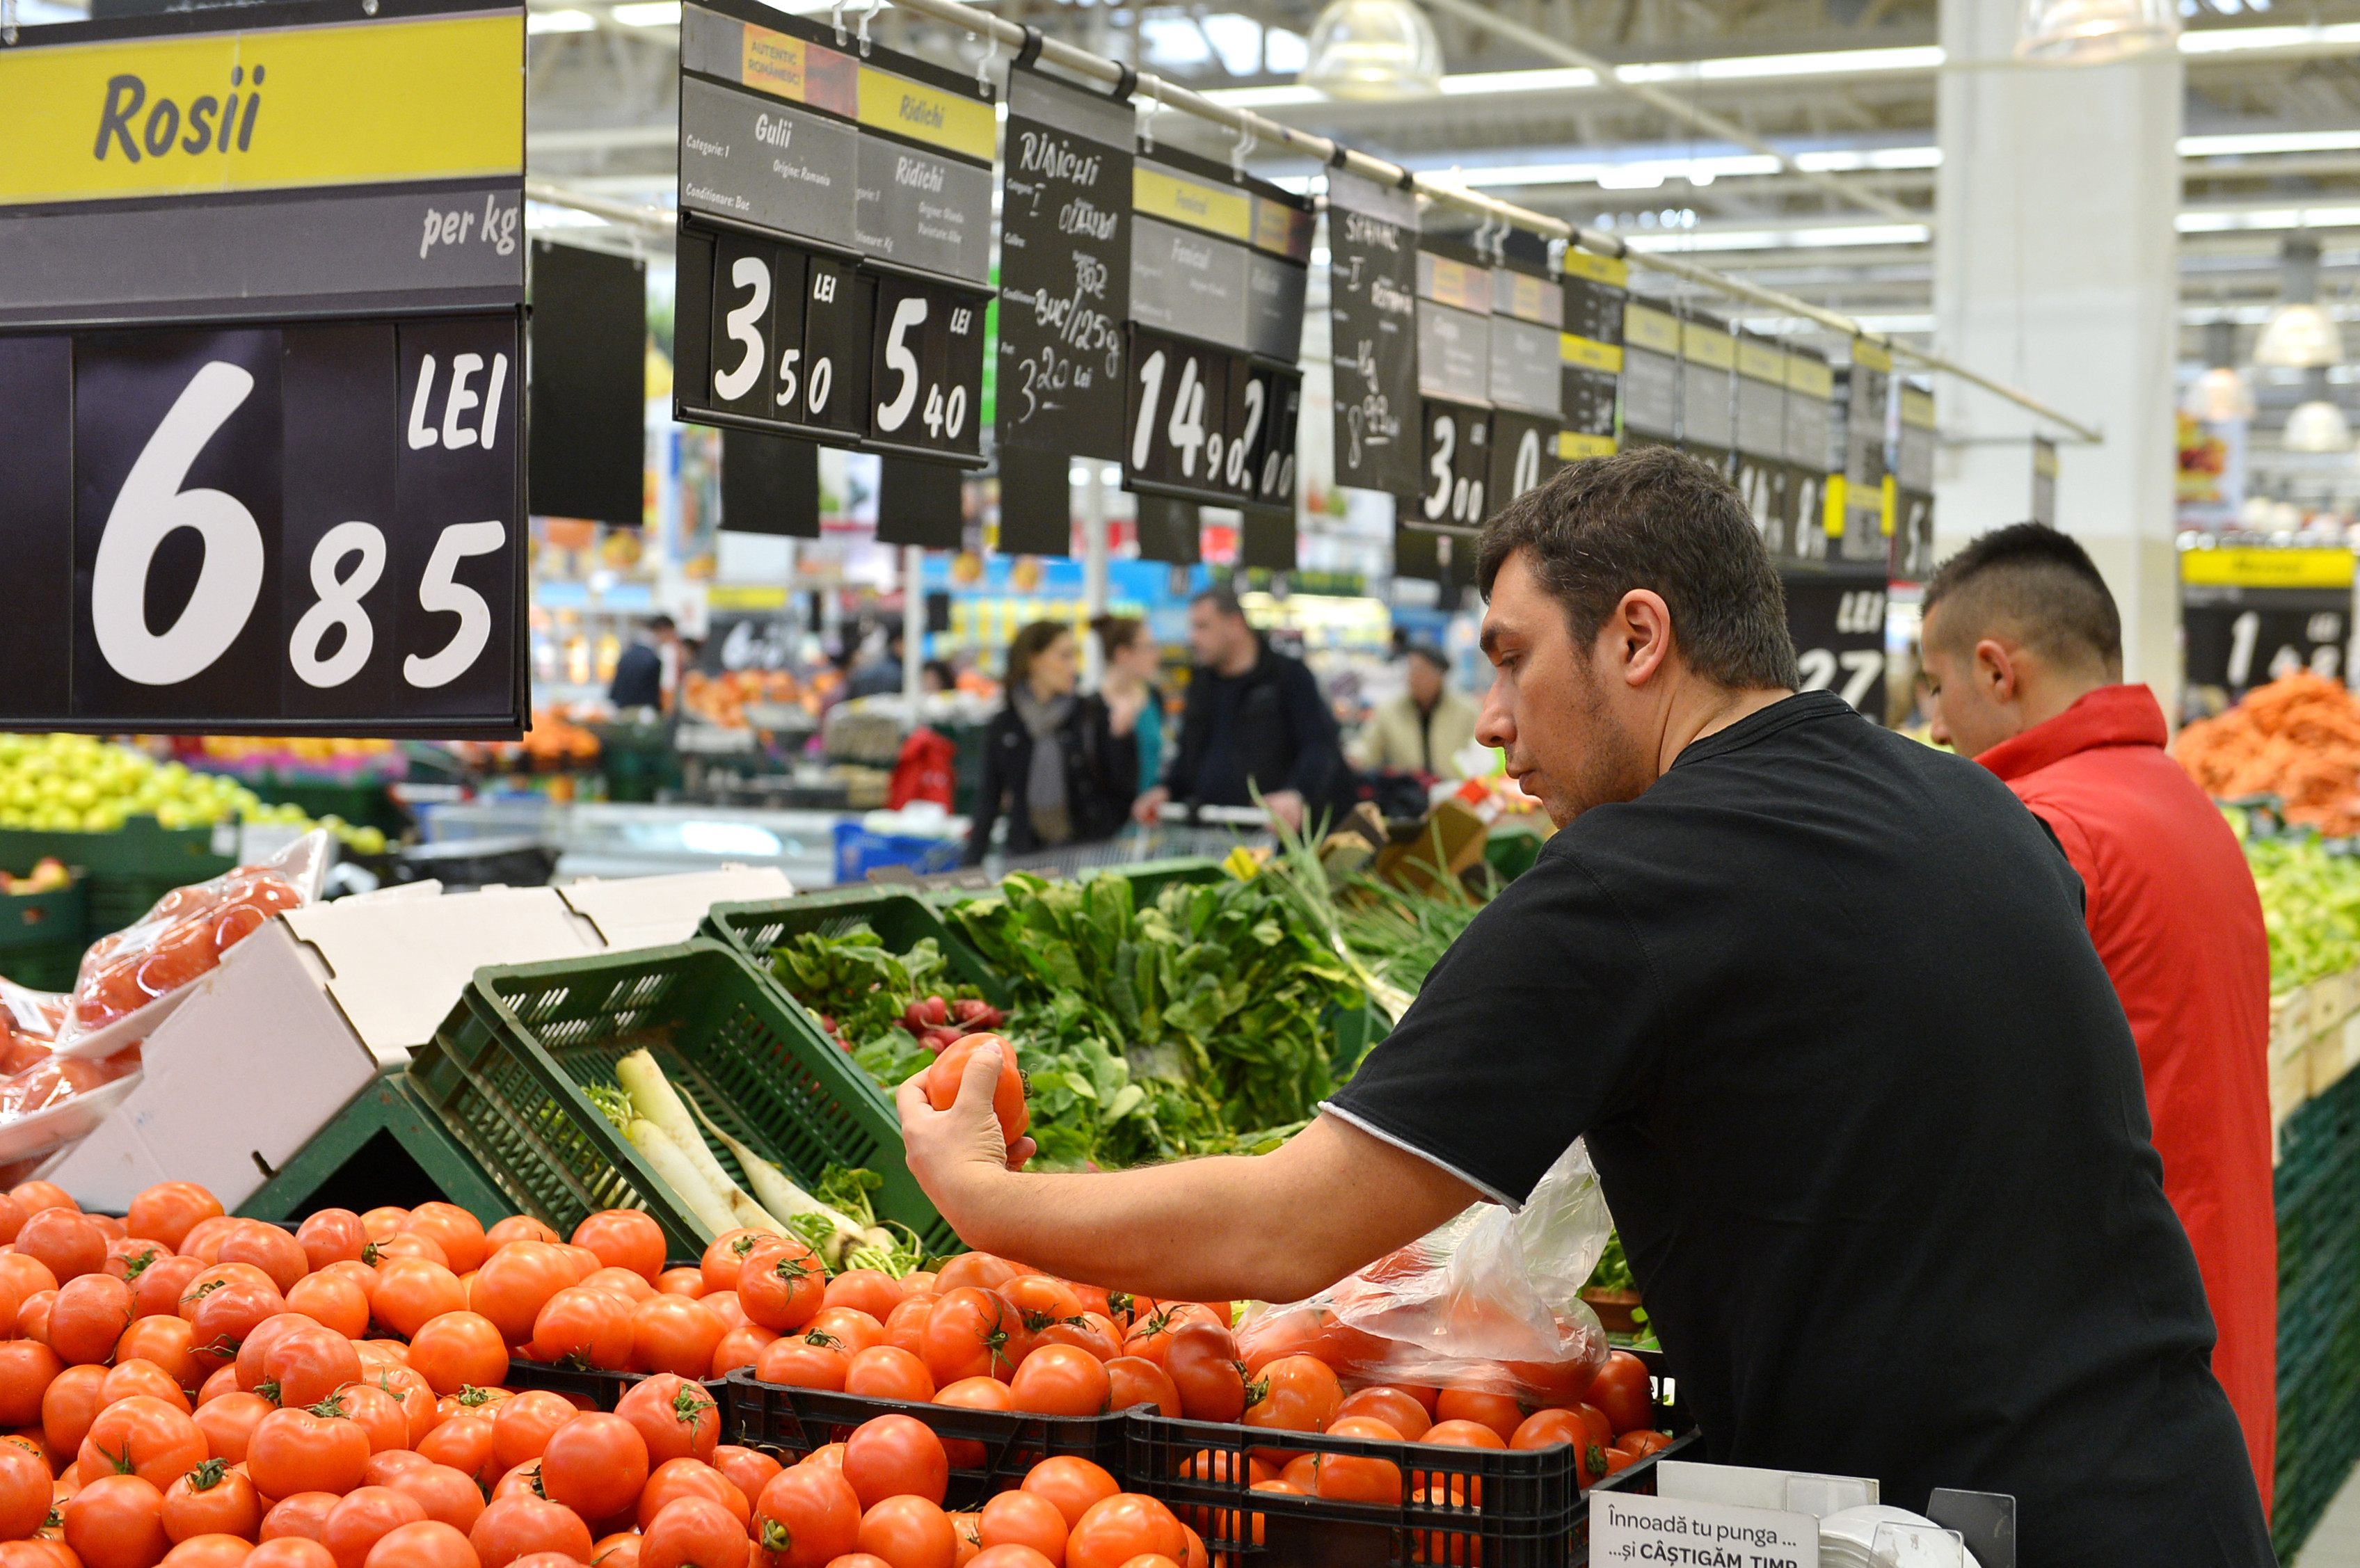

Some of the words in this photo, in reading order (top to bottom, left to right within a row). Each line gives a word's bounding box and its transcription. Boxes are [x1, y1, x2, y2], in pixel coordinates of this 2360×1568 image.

[752, 42, 797, 65] AUTENTIC
[94, 65, 265, 163] Rosii
[755, 113, 793, 149] Gulii
[900, 93, 946, 130] Ridichi
[686, 134, 724, 157] Categorie:
[895, 156, 946, 193] Ridichi
[685, 183, 734, 207] Conditionare:
[420, 207, 474, 259] per
[481, 194, 518, 255] kg
[813, 272, 837, 305] LEI
[714, 256, 772, 401] 3
[776, 348, 833, 415] 50
[950, 307, 973, 336] LEI
[877, 297, 929, 433] 5
[923, 383, 968, 440] 40
[408, 353, 508, 450] LEI
[1131, 349, 1206, 479] 14
[1206, 432, 1245, 487] 90
[1424, 415, 1456, 521] 3
[1452, 477, 1484, 524] 00
[1835, 591, 1887, 634] LEI
[1608, 1503, 1687, 1535] Înnoadă
[1691, 1519, 1712, 1537] tu
[1716, 1523, 1778, 1548] punga
[1640, 1539, 1742, 1568] CÂȘTIGĂM
